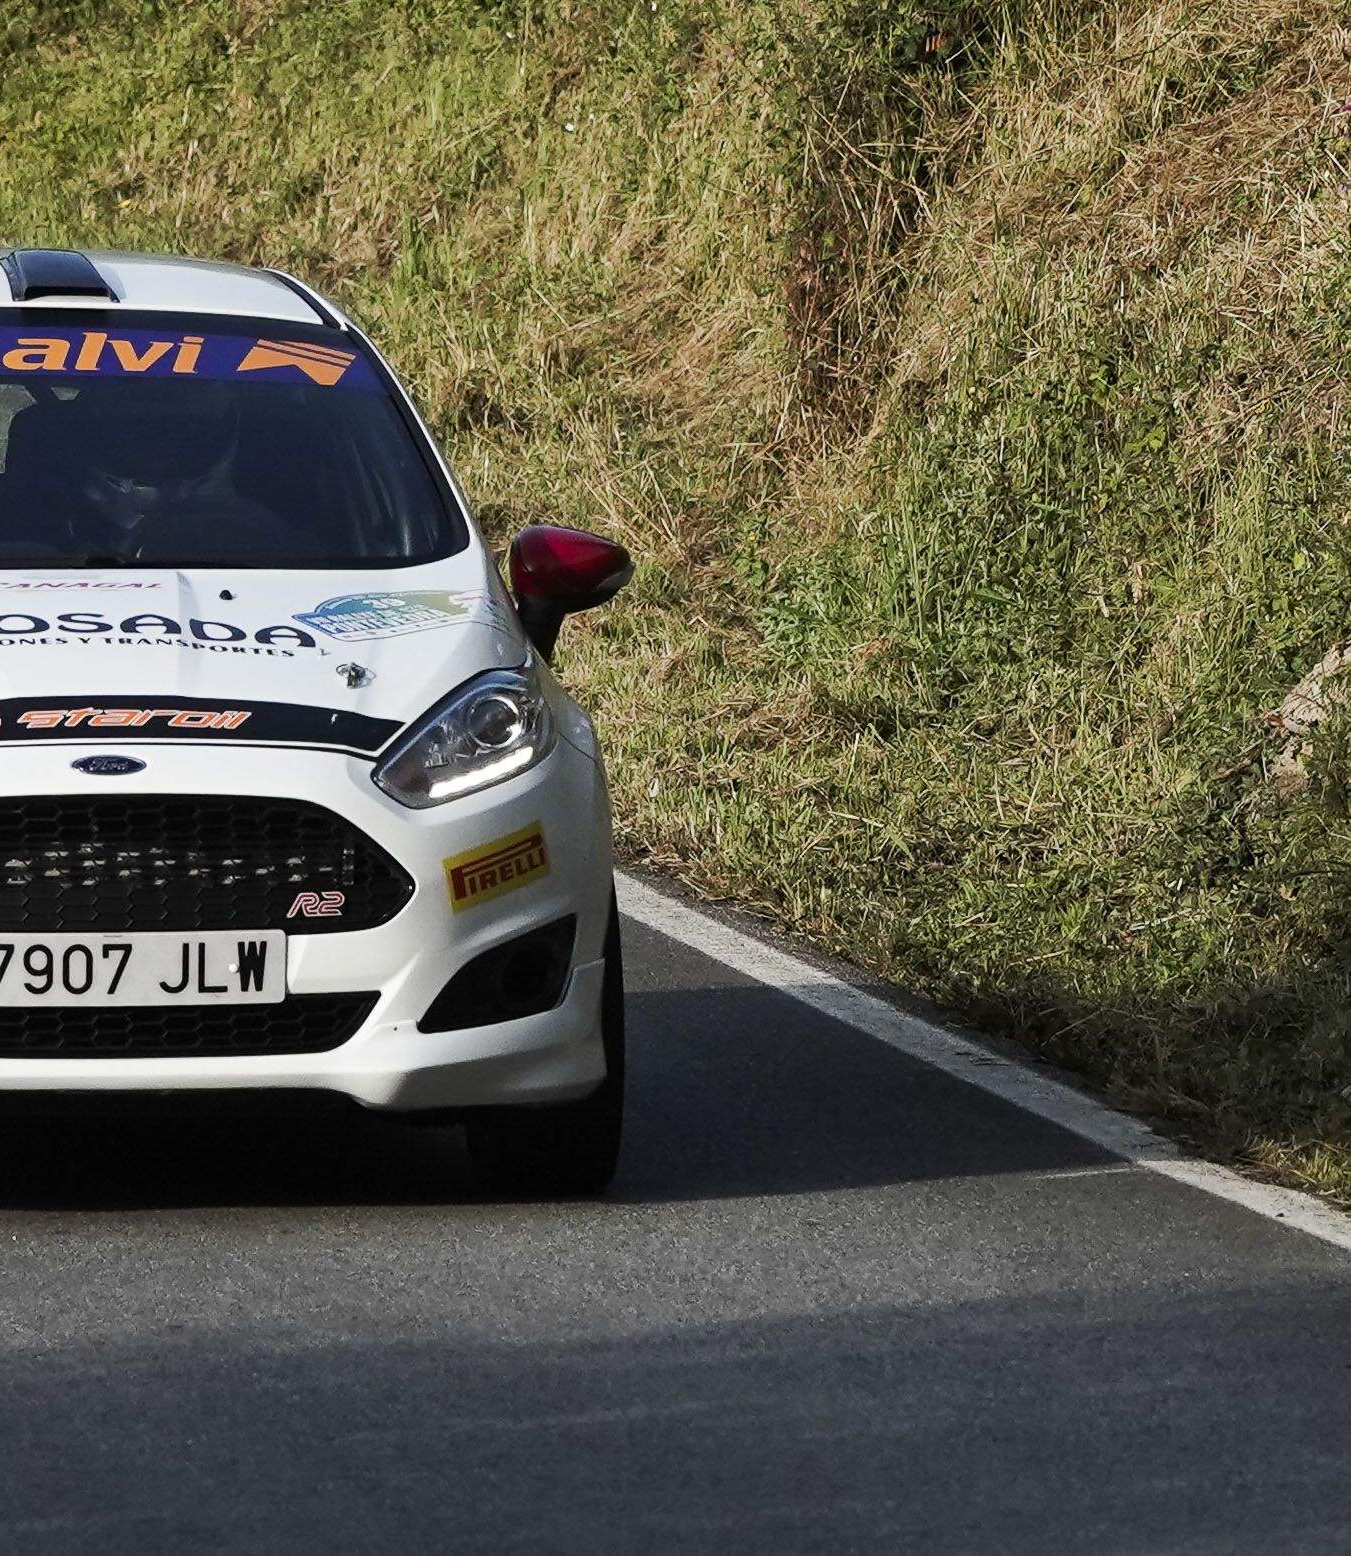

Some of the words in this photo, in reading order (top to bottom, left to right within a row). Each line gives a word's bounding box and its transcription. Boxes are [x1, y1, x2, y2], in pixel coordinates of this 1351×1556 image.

[104, 638, 295, 657] TRANSPORTES
[450, 832, 546, 901] PIRELLI
[286, 891, 346, 919] R2
[159, 941, 267, 994] JLW
